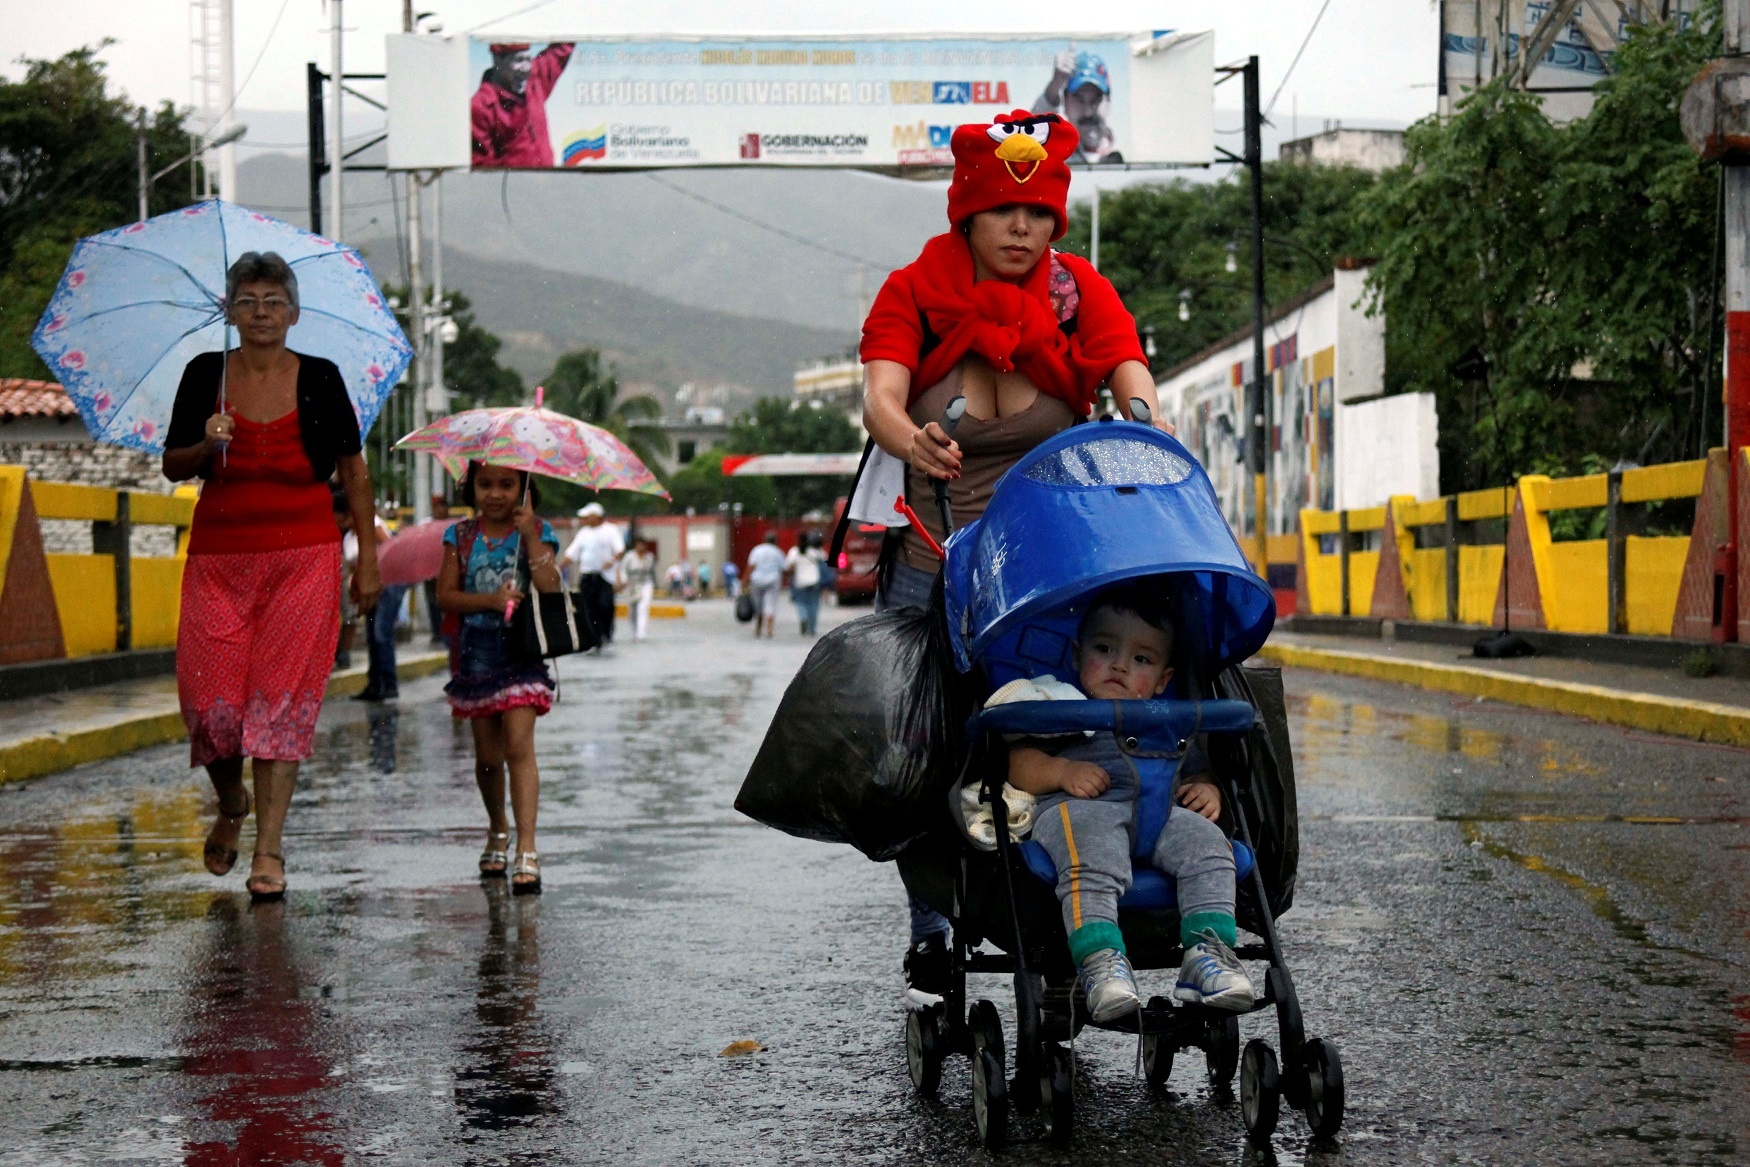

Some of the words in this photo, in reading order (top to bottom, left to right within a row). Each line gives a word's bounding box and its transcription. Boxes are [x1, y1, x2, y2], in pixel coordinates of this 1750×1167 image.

[573, 77, 698, 106] REPÚBLICA
[700, 79, 853, 107] BOLIVARIANA
[855, 79, 887, 106] DE
[610, 134, 690, 147] Bolivariano
[762, 131, 868, 147] GOBERNACIÓN
